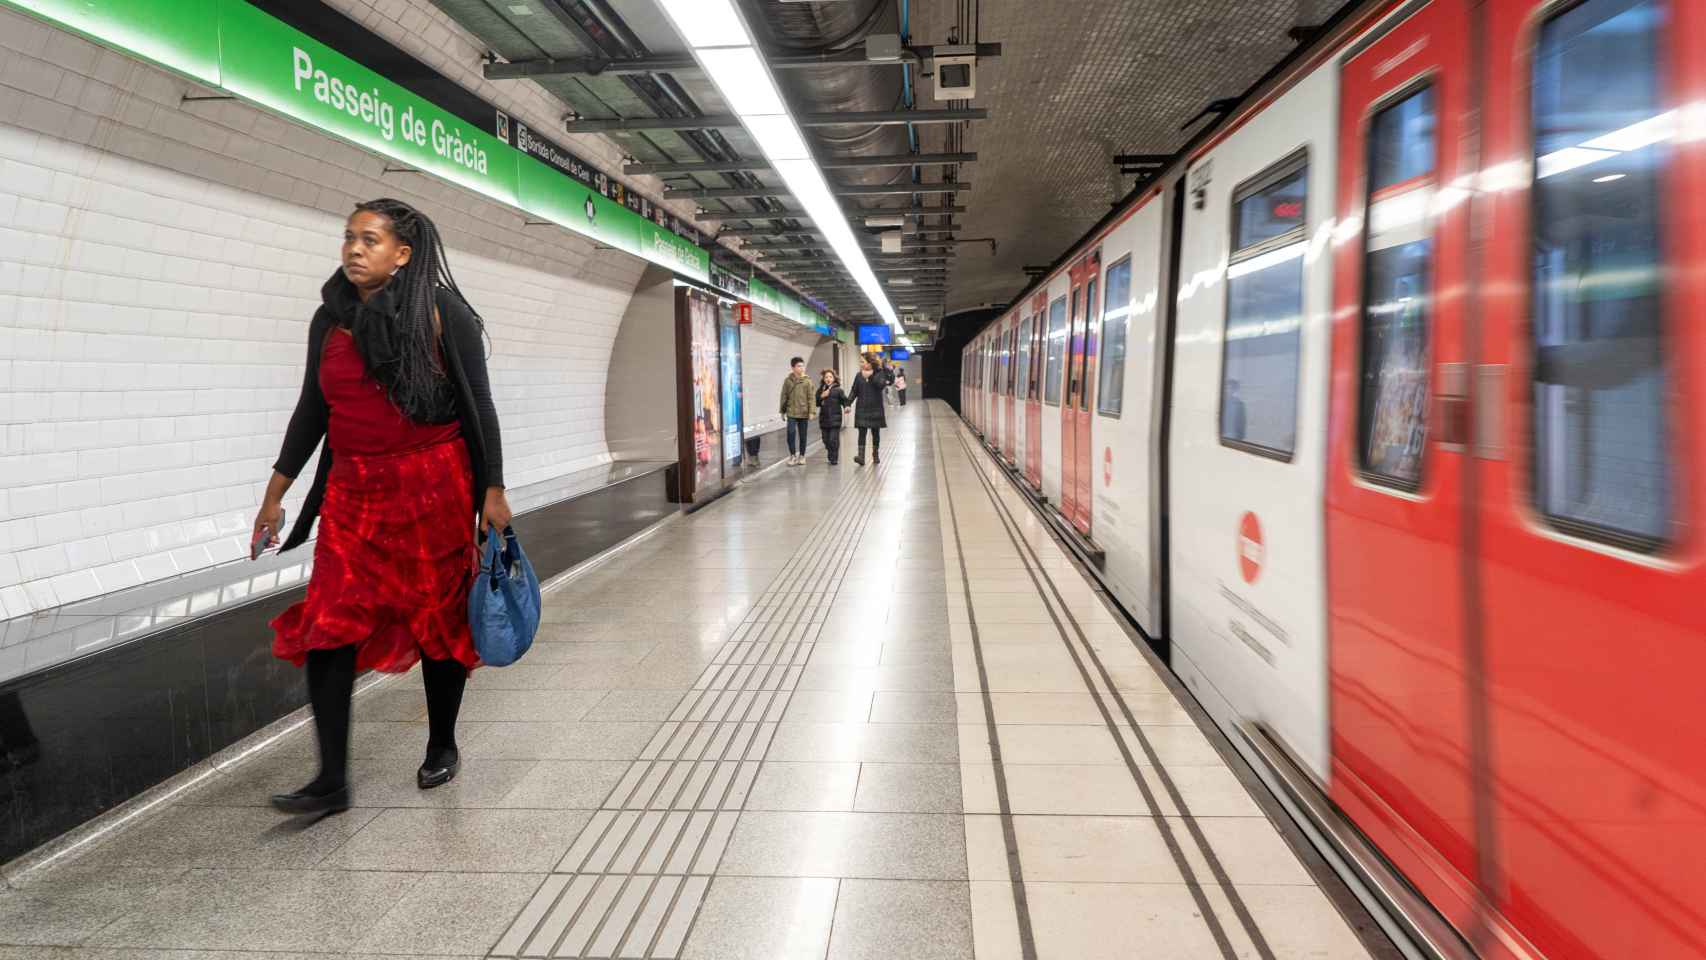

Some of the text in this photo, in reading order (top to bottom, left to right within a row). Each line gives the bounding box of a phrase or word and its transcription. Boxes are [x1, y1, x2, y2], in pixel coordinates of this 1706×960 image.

[293, 46, 488, 175] Passeig de Gràcia
[527, 134, 549, 160] Sortida
